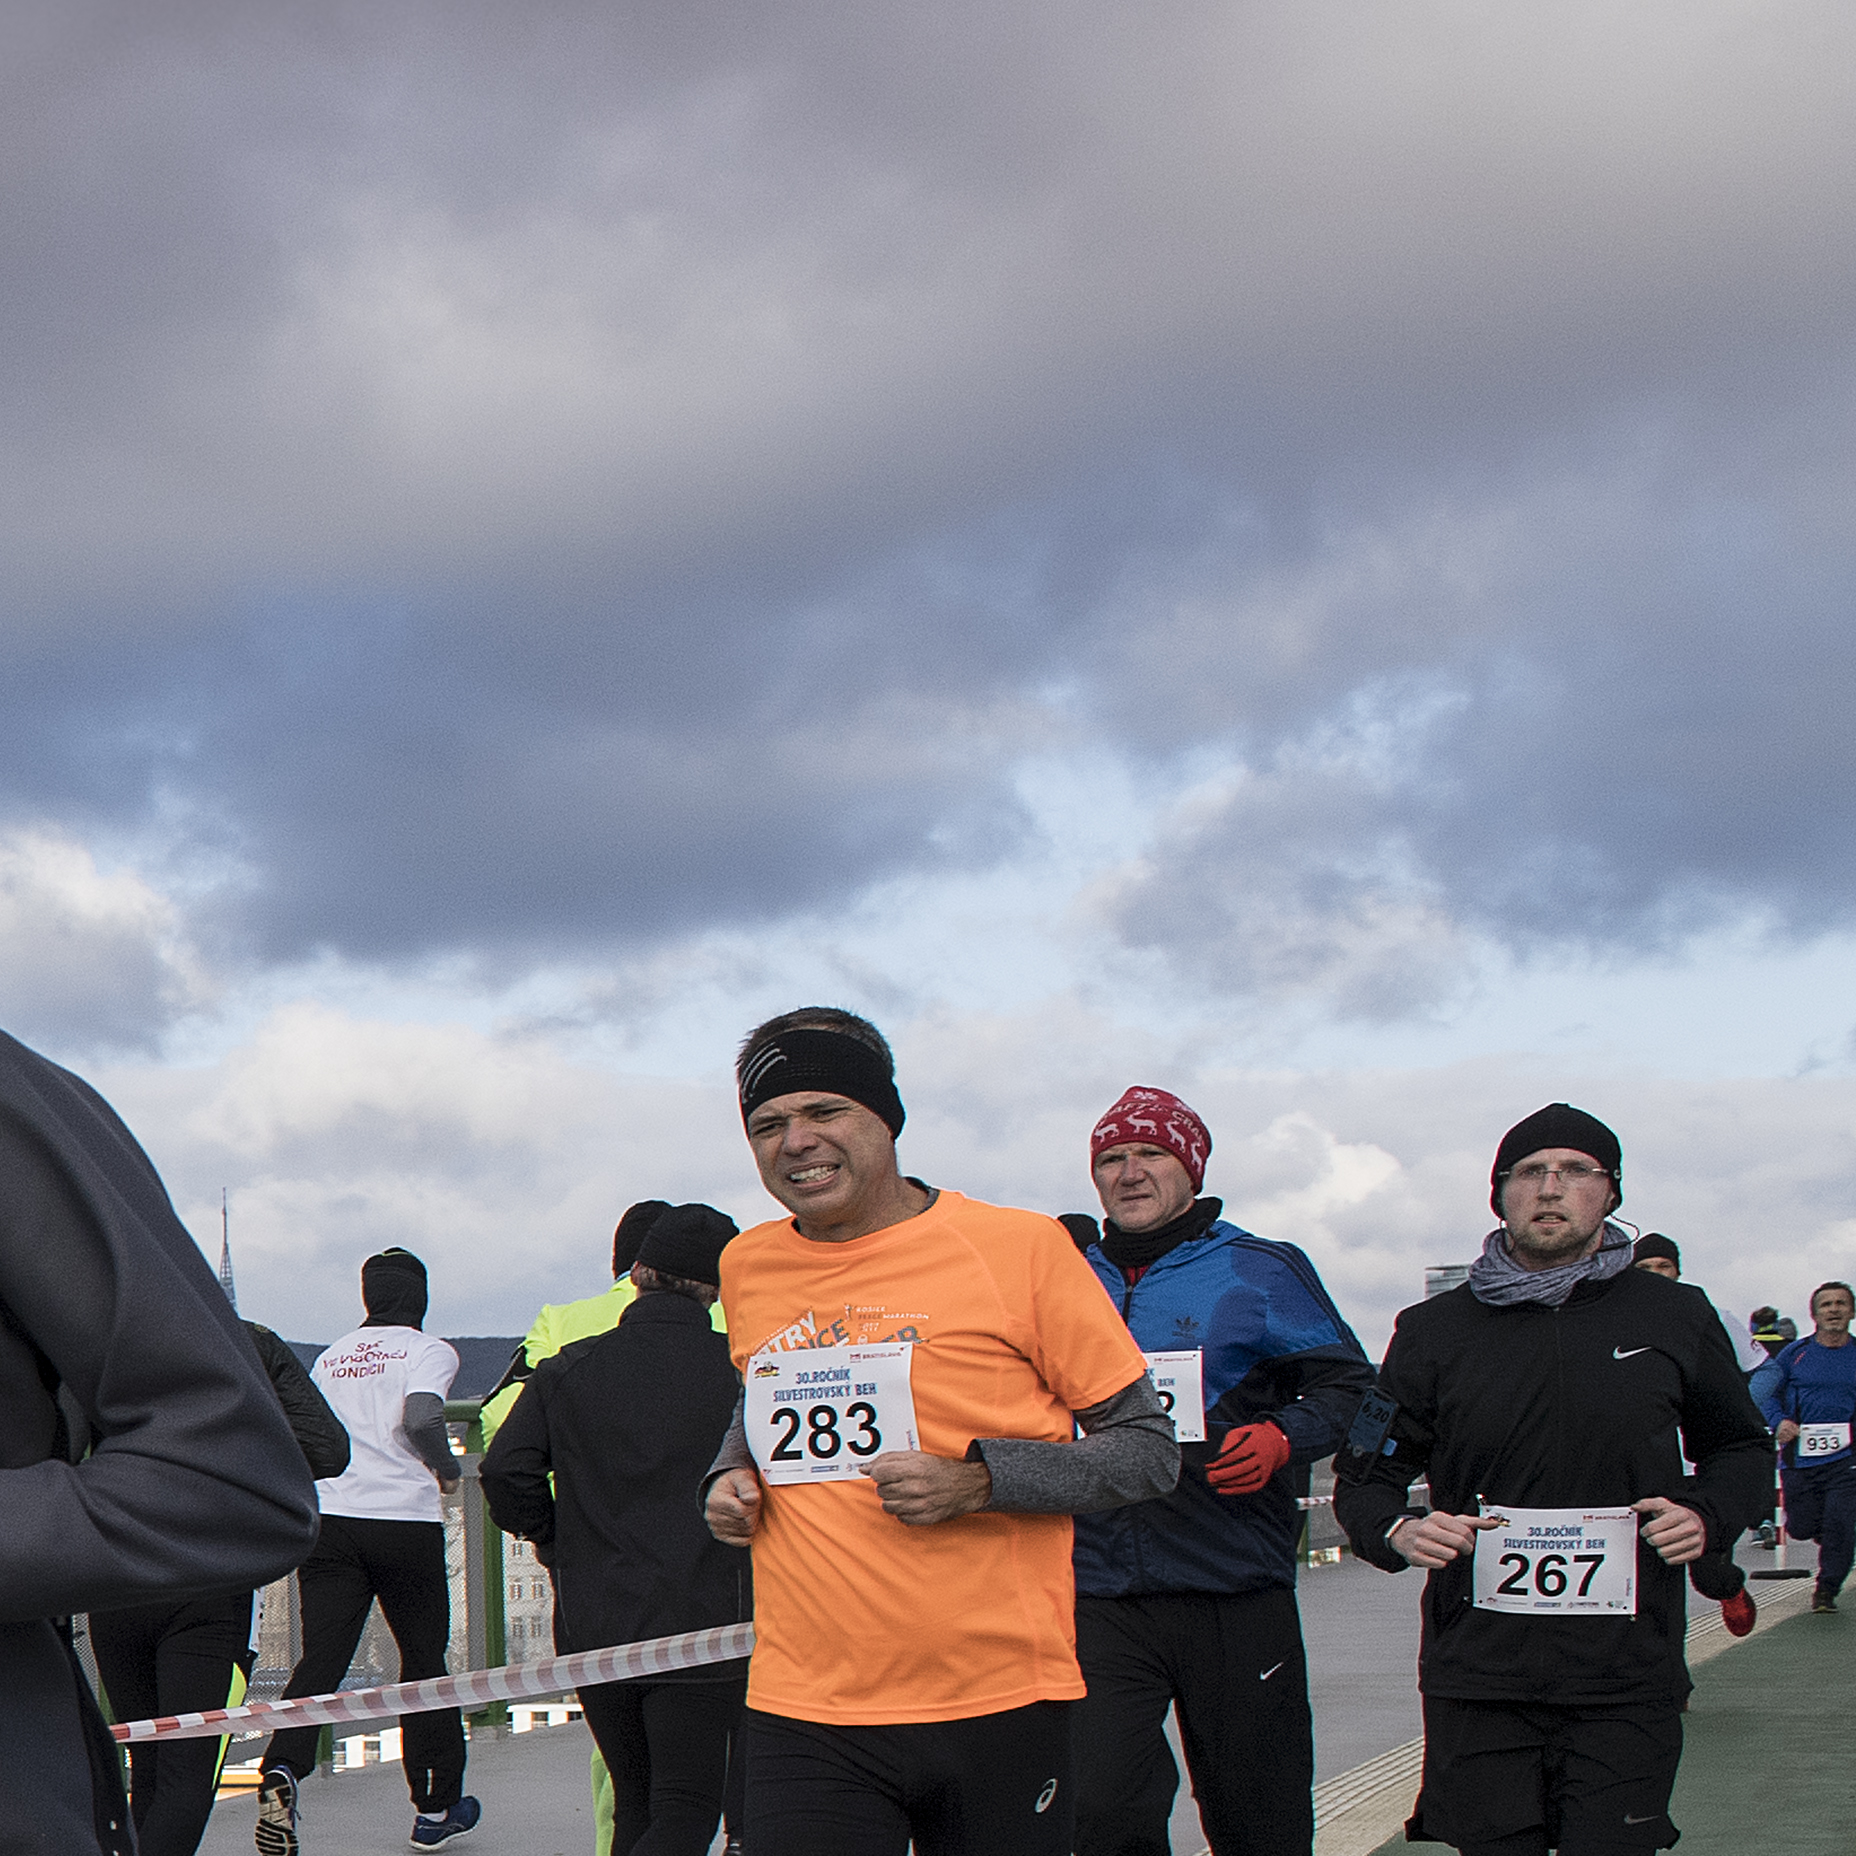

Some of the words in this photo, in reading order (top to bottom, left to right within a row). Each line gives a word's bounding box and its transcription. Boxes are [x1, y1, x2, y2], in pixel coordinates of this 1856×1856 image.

[795, 1366, 851, 1385] 30.ROČNÍK
[773, 1382, 852, 1402] SILVESTROVSKÝ
[856, 1383, 878, 1396] BEH
[770, 1402, 882, 1462] 283
[1807, 1437, 1841, 1451] 933
[1503, 1538, 1582, 1550] SILVESTROVSKÝ
[1586, 1539, 1606, 1549] BEH
[1496, 1552, 1606, 1597] 267
